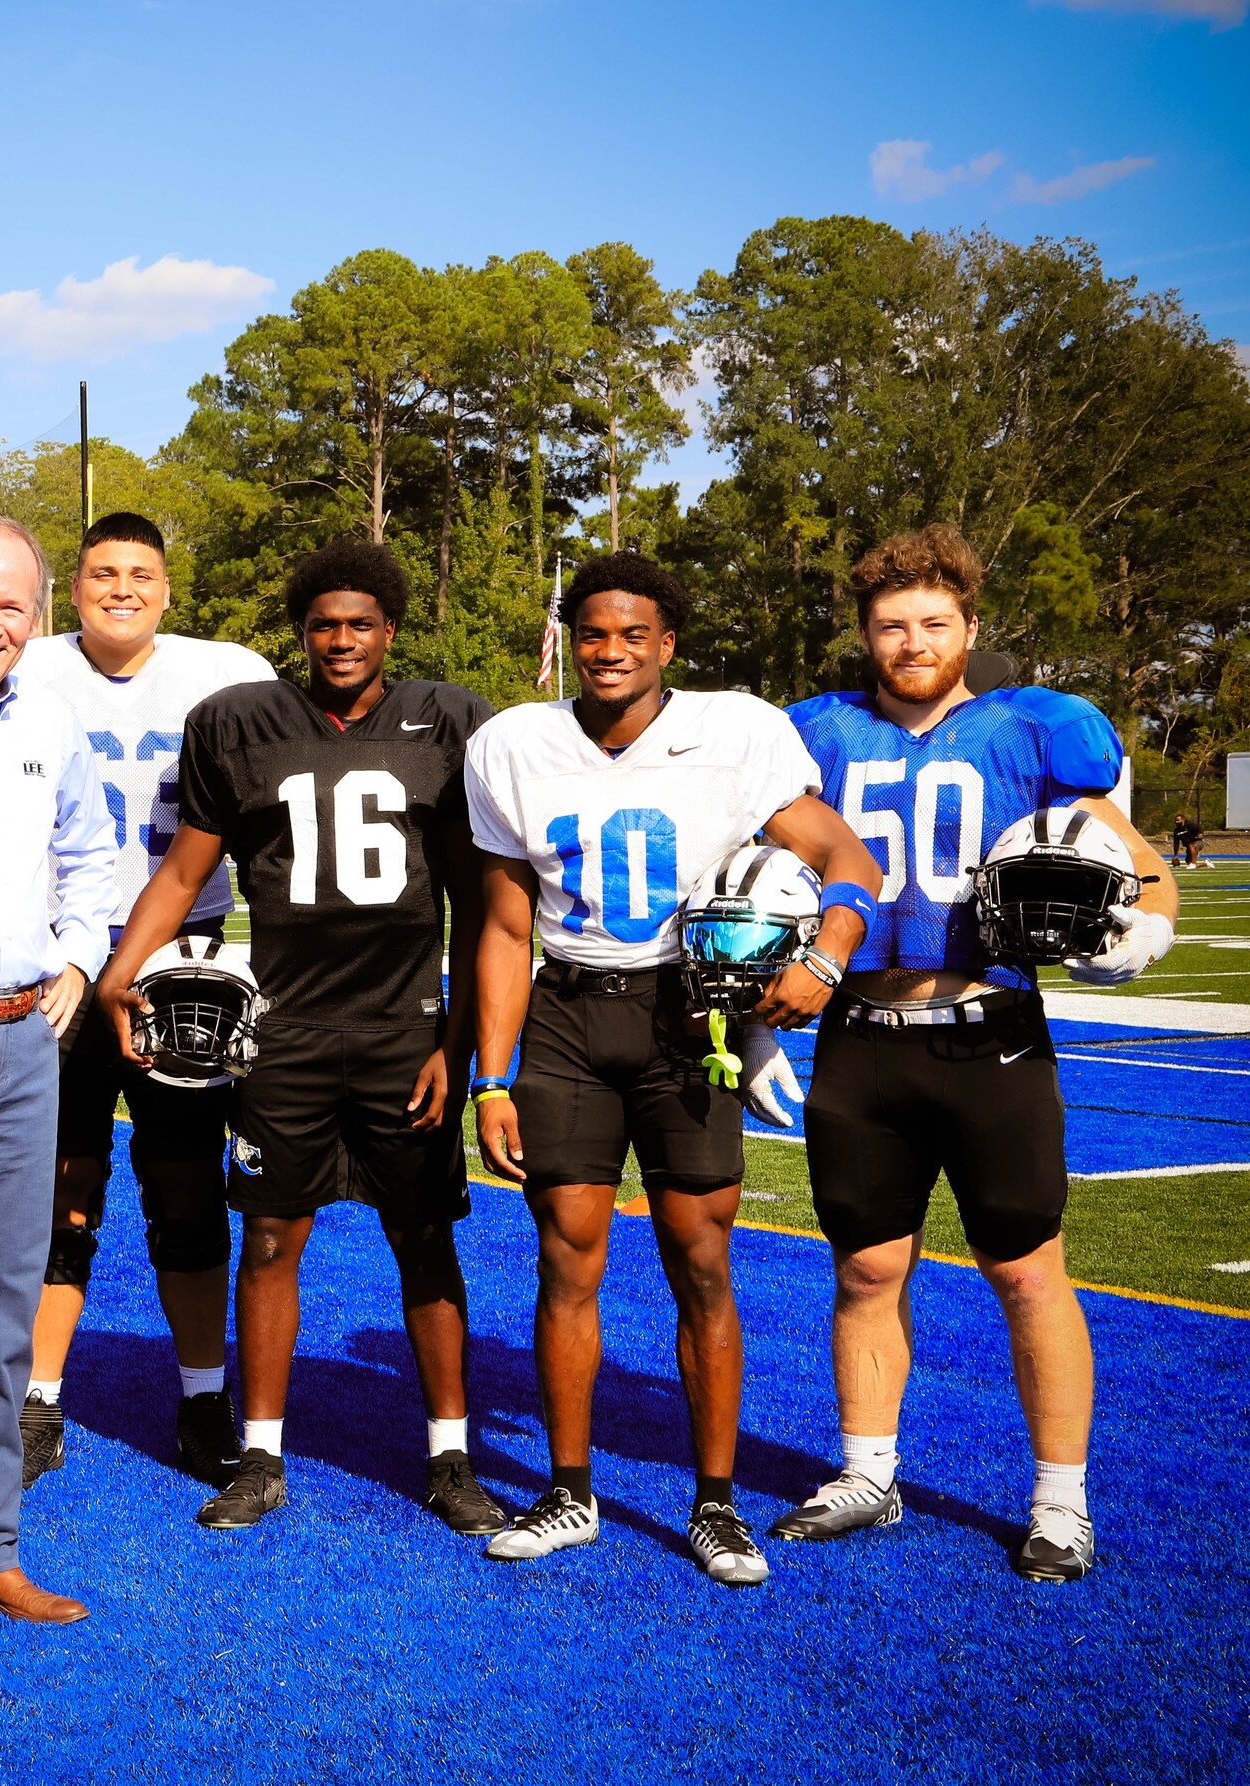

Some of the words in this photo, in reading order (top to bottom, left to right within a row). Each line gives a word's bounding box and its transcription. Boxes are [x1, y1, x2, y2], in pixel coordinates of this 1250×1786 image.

[23, 763, 44, 774] LEE
[278, 770, 408, 905] 16
[842, 757, 984, 903] 50
[1032, 846, 1075, 856] Riddell
[546, 808, 678, 943] 10
[710, 899, 749, 909] Riddell
